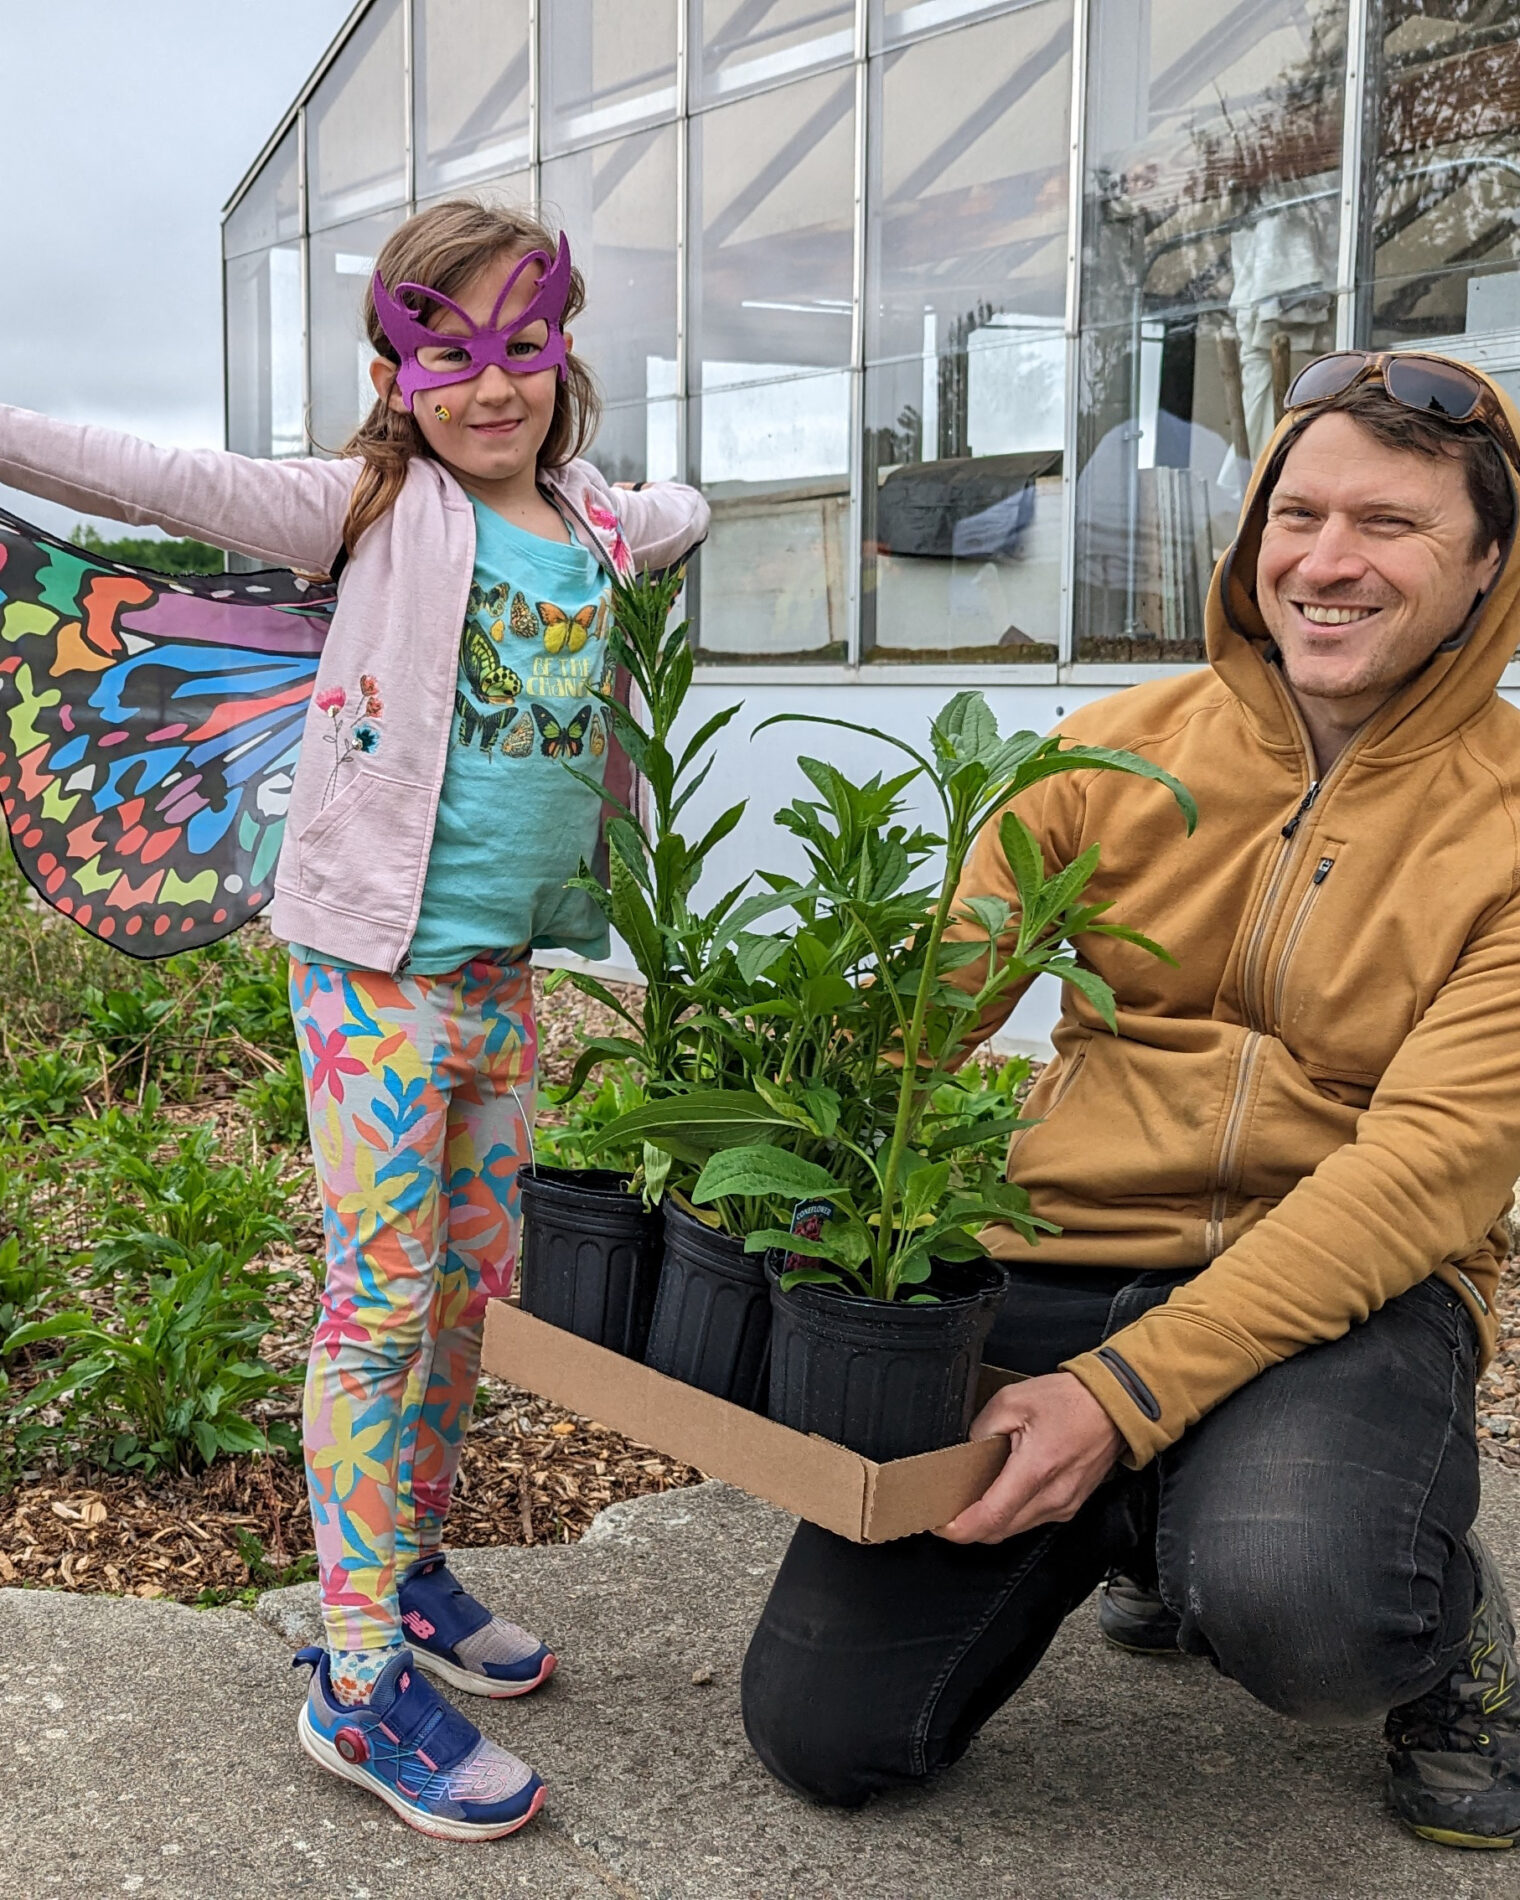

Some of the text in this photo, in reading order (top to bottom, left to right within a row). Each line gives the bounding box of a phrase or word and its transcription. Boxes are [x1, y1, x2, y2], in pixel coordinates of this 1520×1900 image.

[533, 657, 591, 676] BE THE
[796, 1205, 832, 1220] CONEFLOWER
